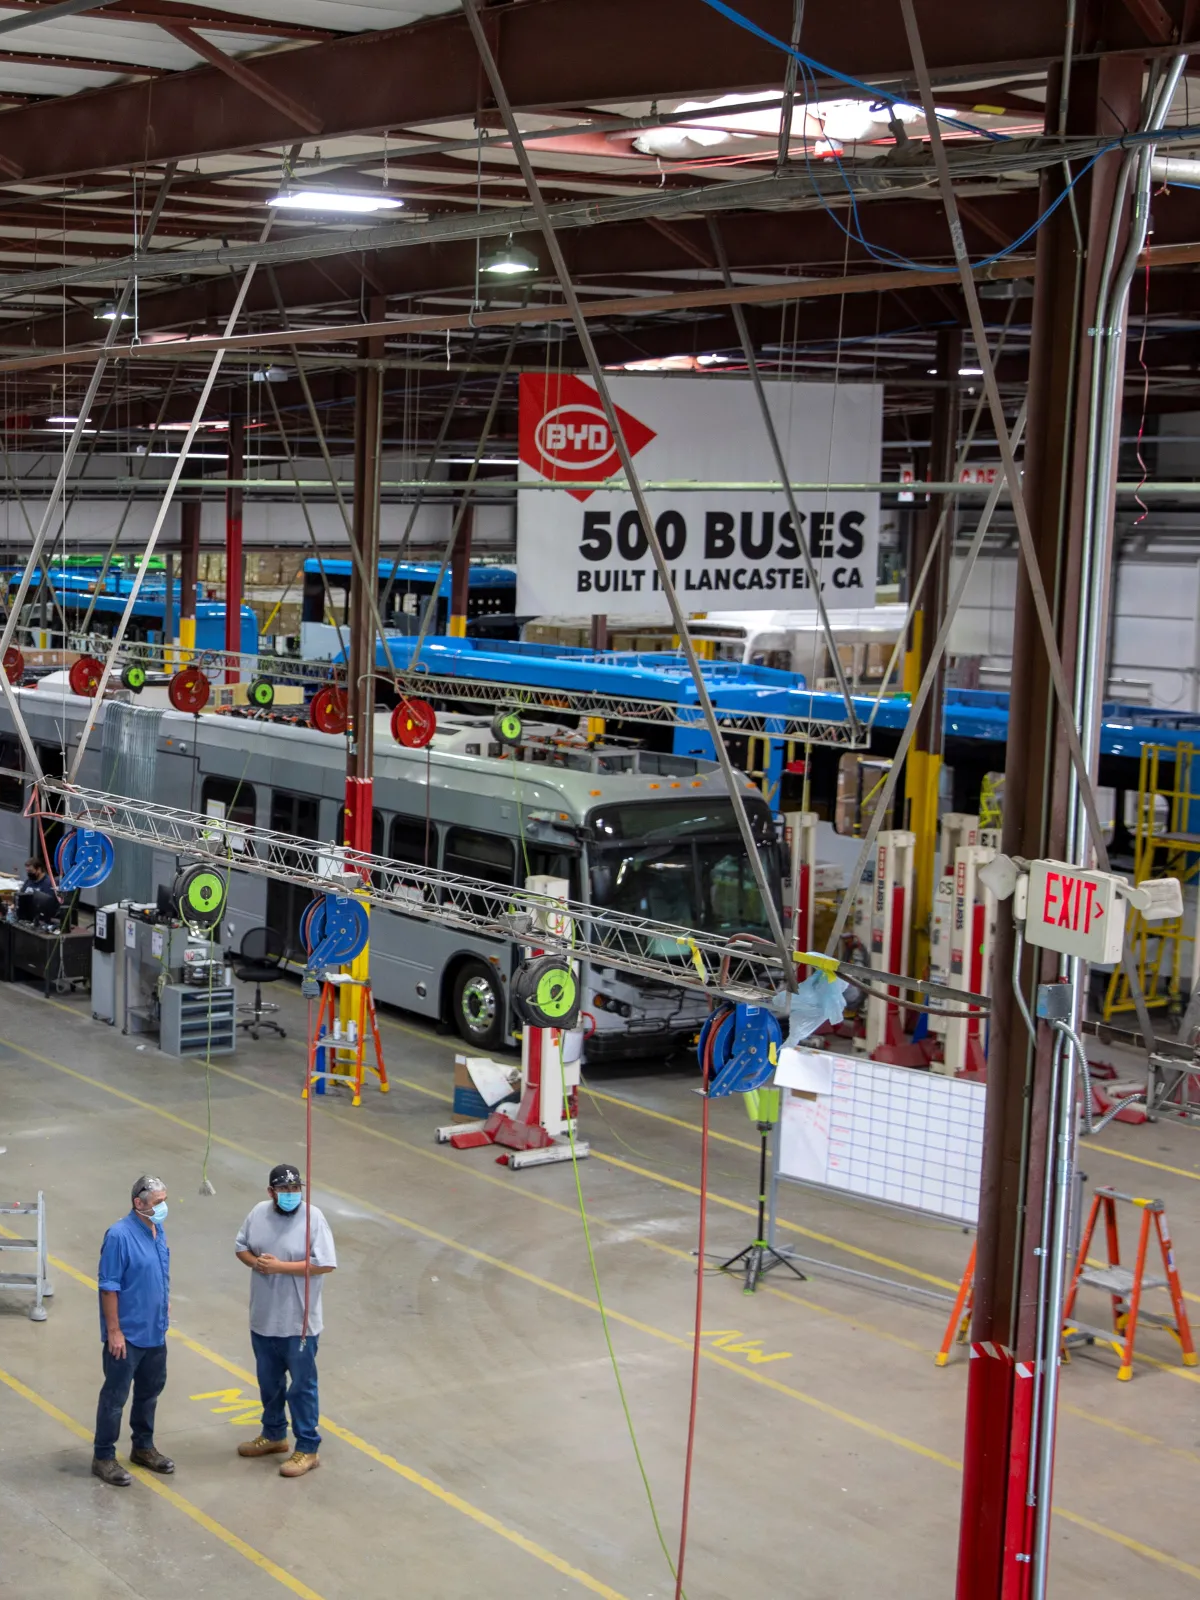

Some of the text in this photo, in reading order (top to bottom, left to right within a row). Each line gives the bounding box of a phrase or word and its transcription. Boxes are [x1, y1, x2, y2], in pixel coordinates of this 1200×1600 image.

[546, 423, 608, 450] BYD
[579, 510, 865, 561] 500 BUSES
[577, 570, 645, 592] BUILT
[833, 567, 863, 589] CA
[1043, 872, 1097, 934] EXIT
